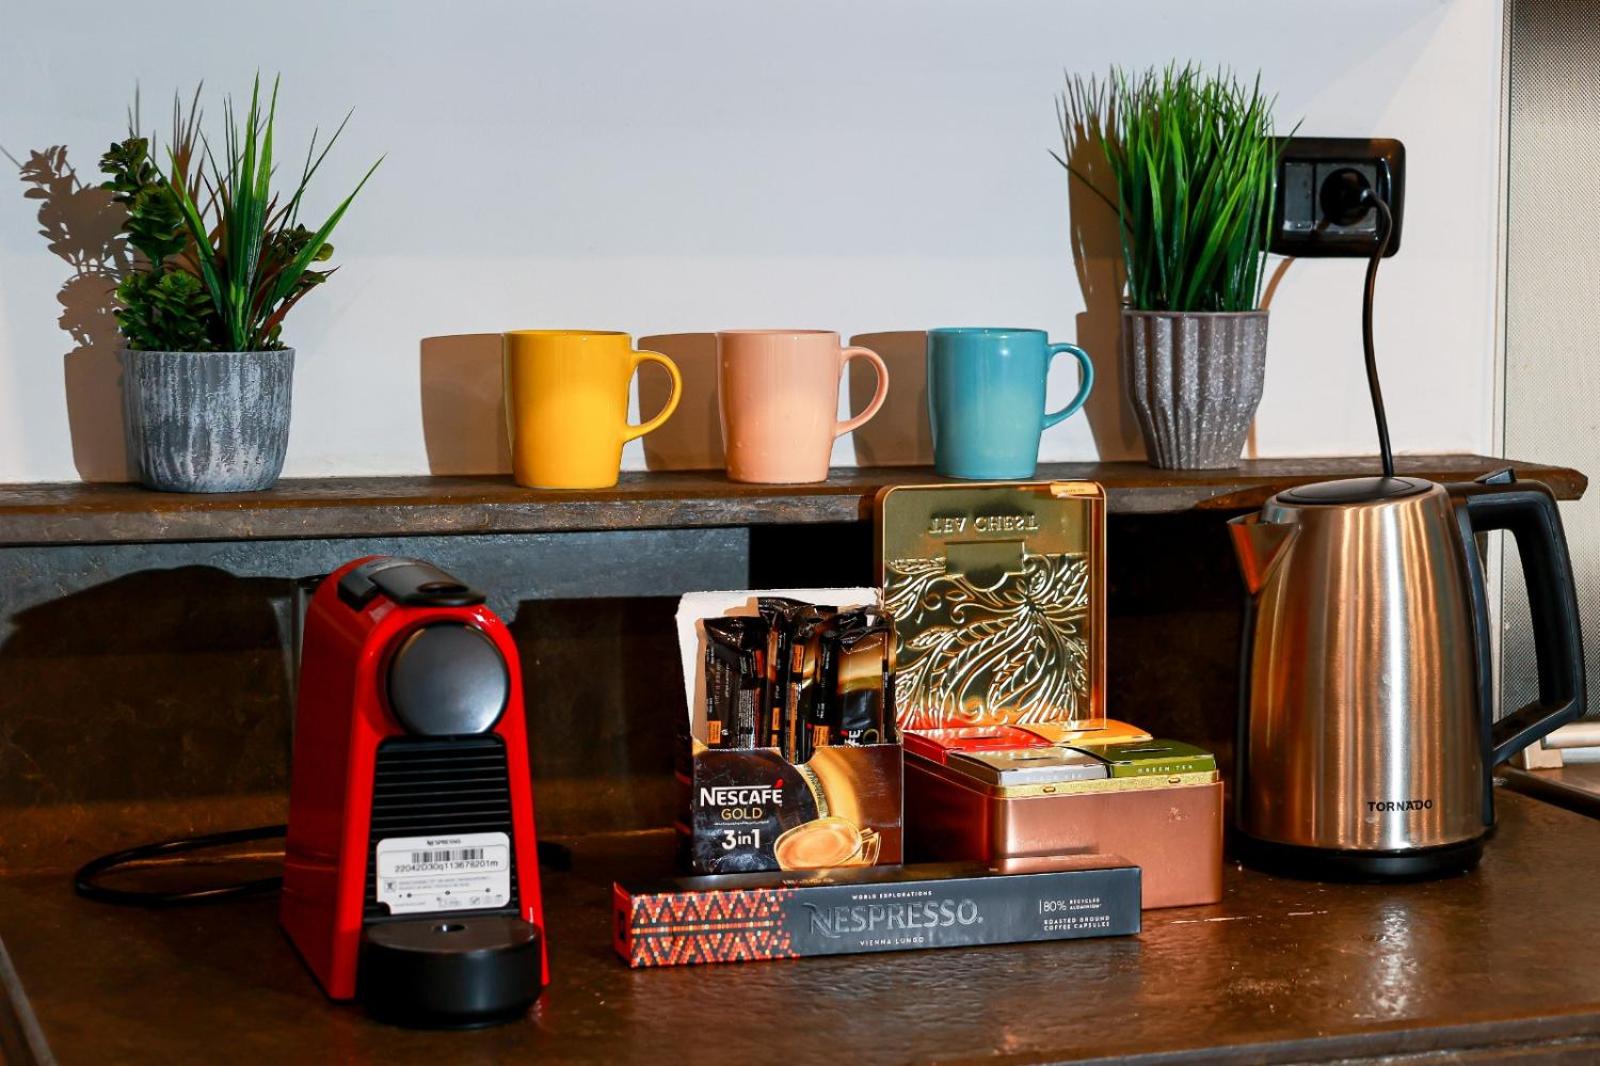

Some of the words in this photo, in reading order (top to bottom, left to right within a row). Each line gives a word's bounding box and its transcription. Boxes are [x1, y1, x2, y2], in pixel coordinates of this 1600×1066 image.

[1367, 799, 1433, 812] TORNADO
[721, 807, 763, 820] GOLD
[1043, 900, 1067, 912] 80%
